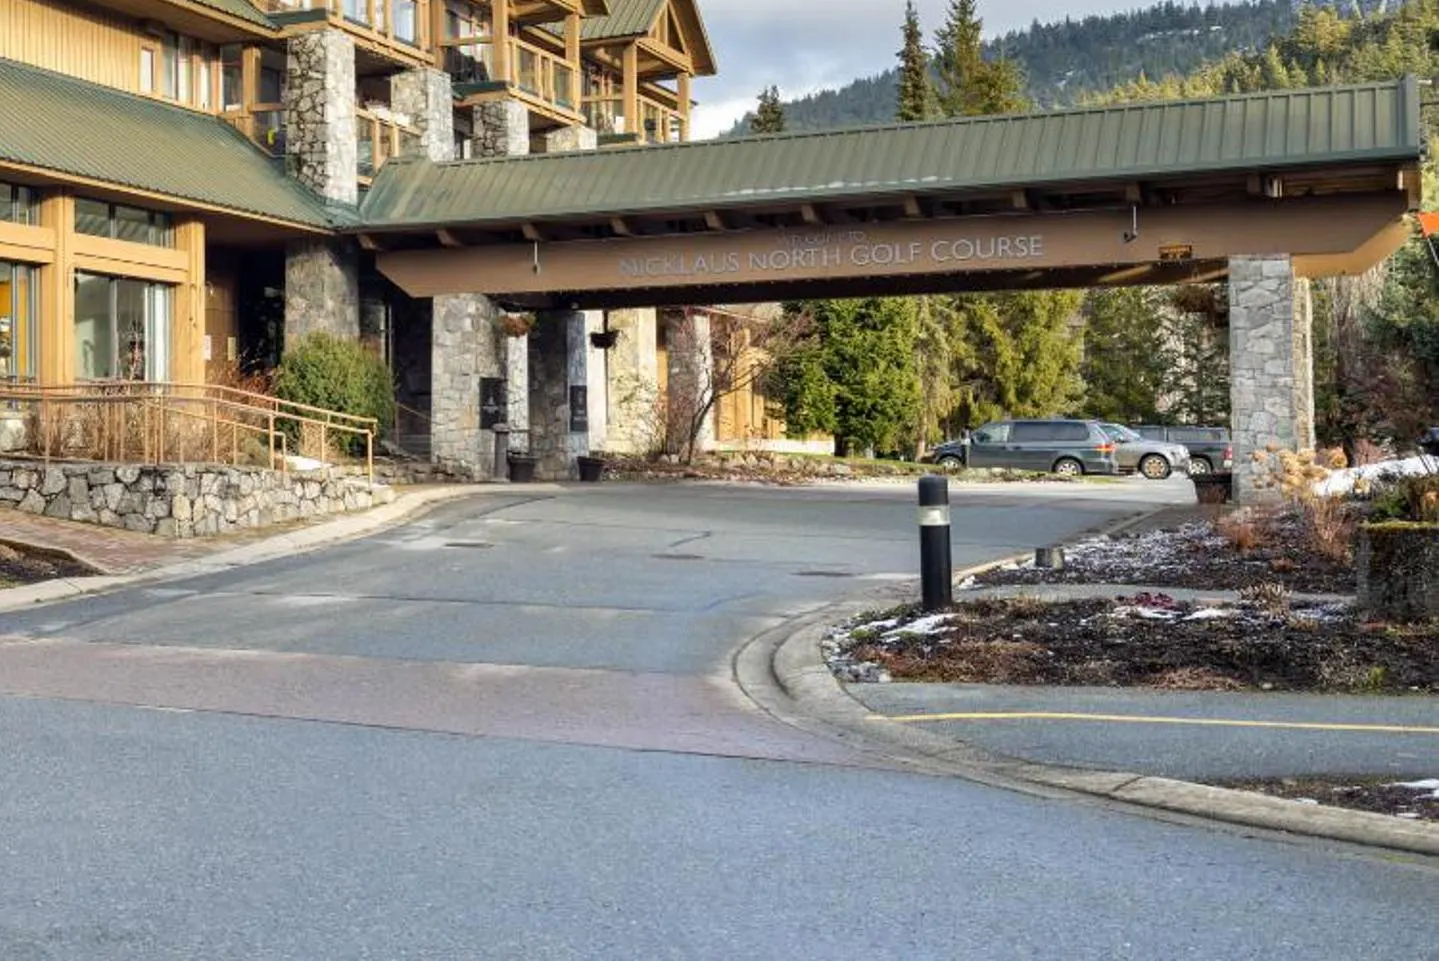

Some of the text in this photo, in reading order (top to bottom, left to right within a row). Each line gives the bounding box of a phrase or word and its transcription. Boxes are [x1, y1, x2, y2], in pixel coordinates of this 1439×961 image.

[848, 230, 866, 242] TO
[618, 235, 1044, 276] NICKLAUS NORTH GOLF COURSE
